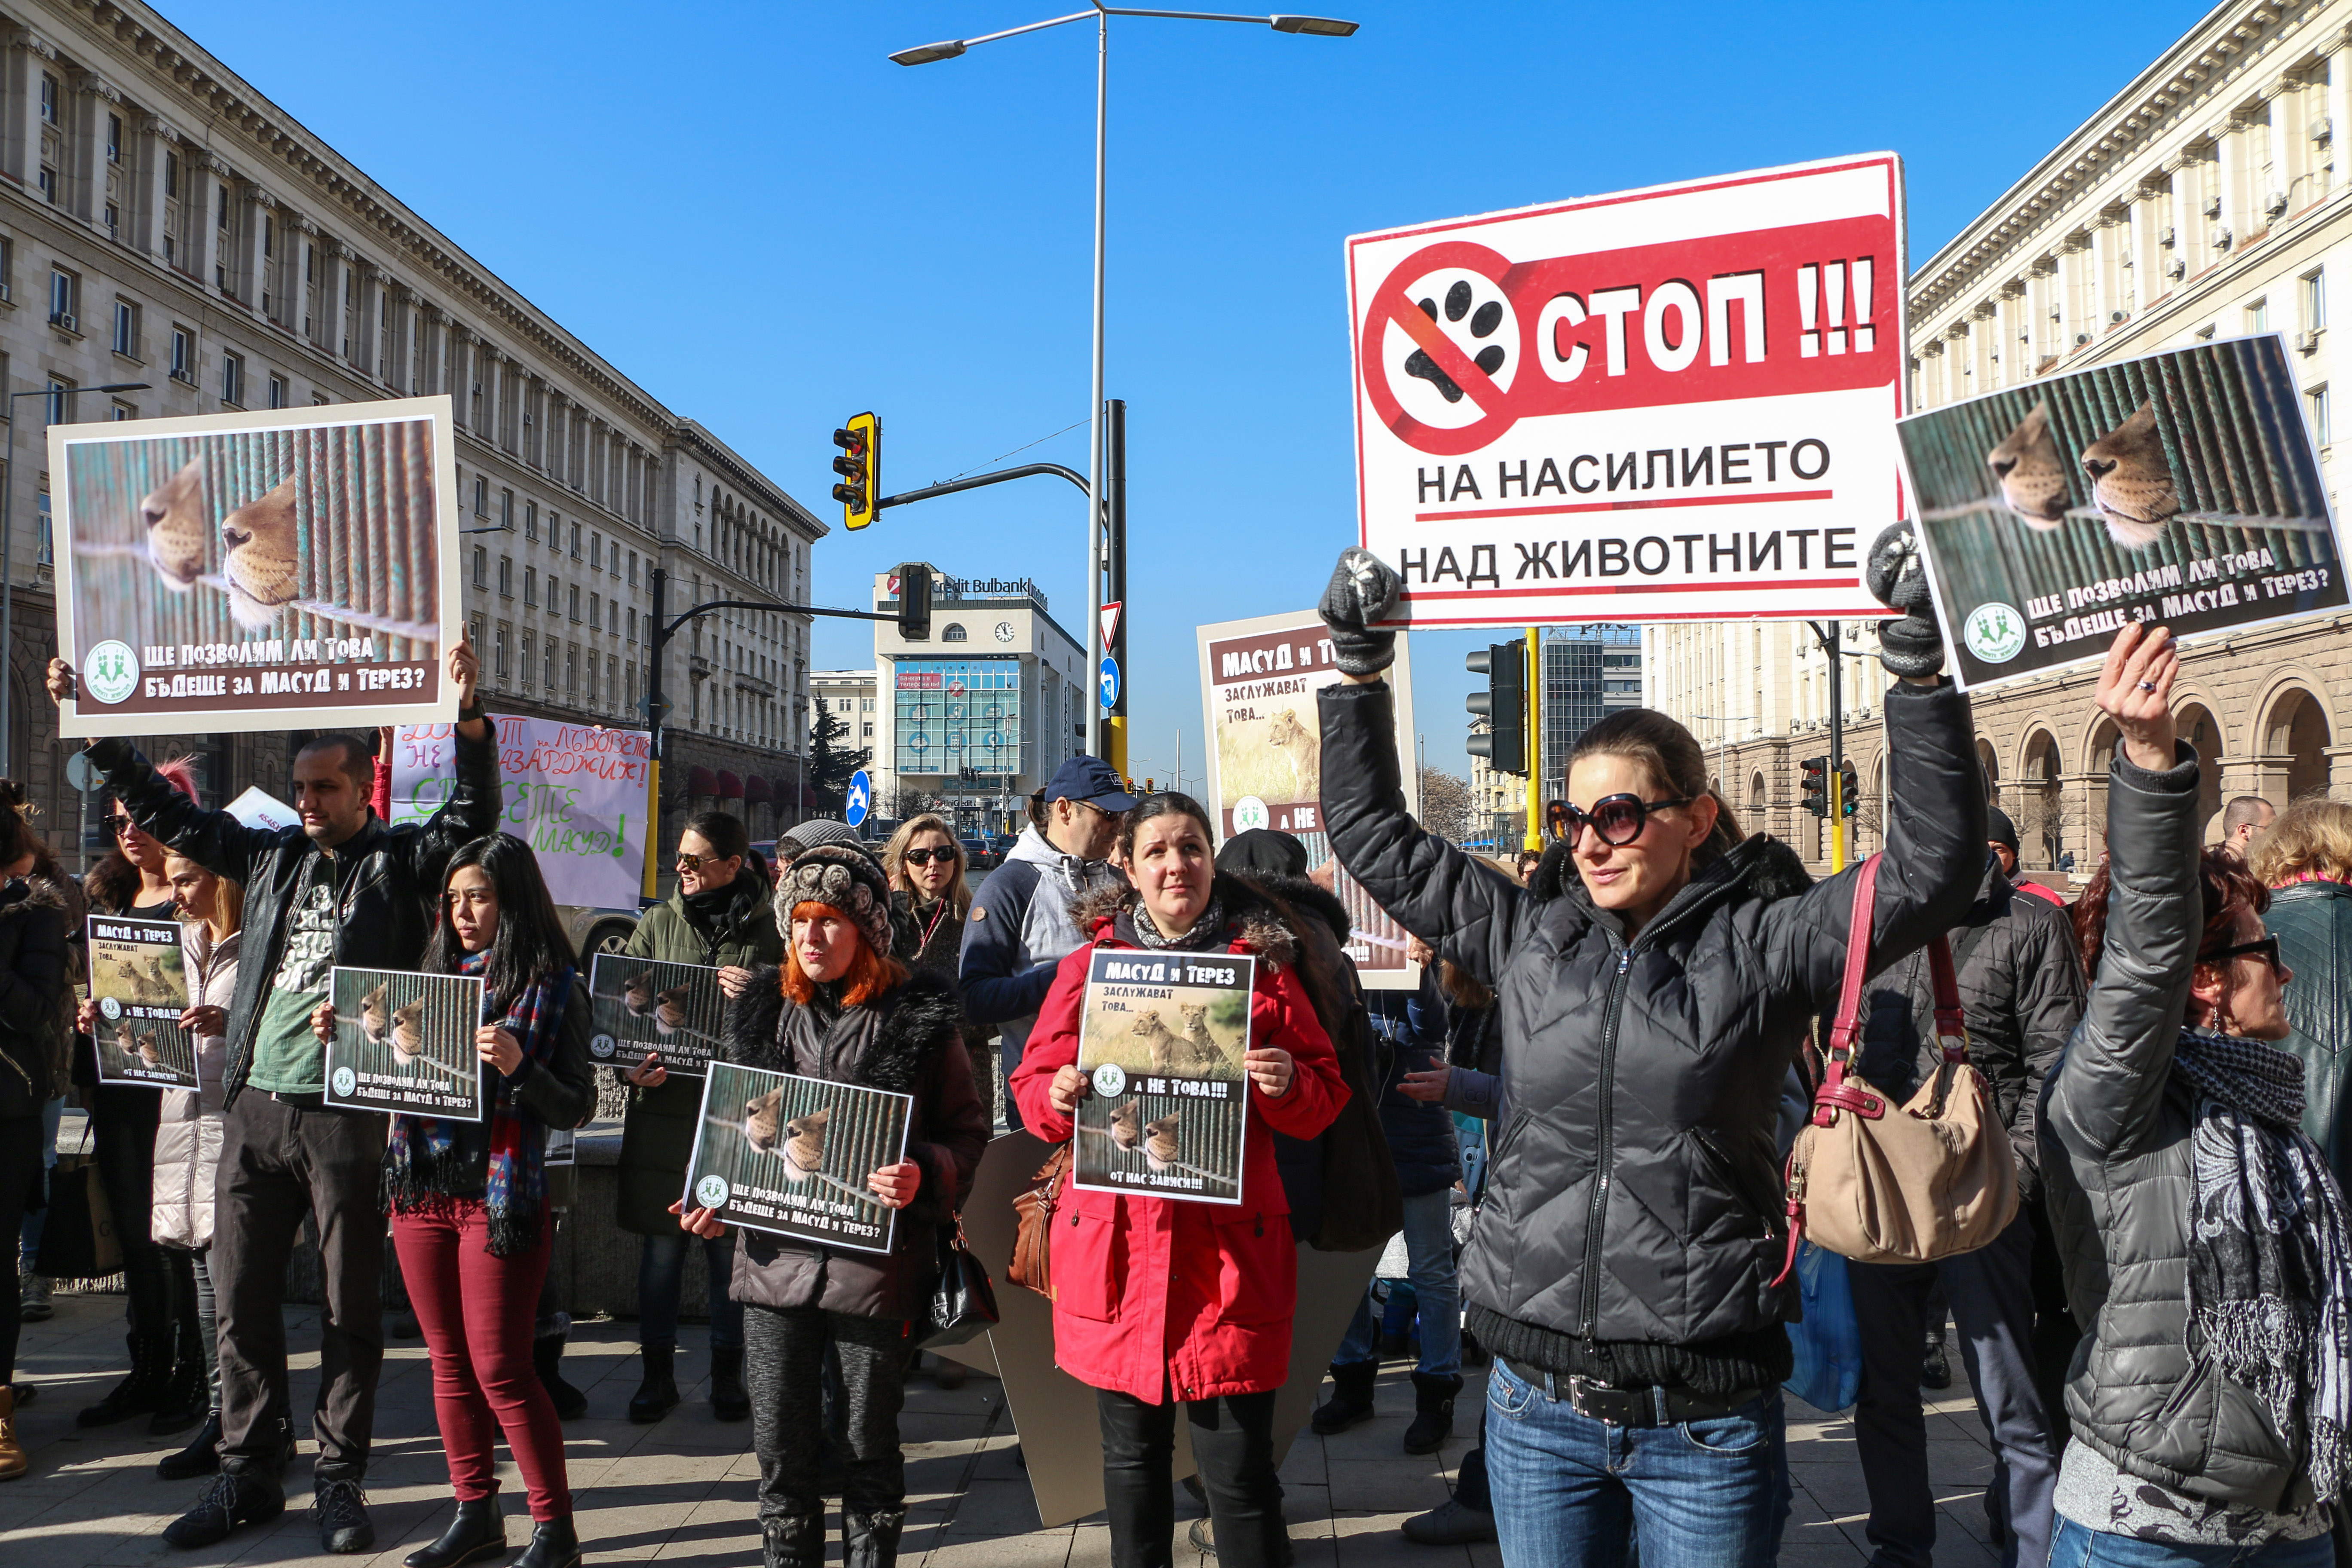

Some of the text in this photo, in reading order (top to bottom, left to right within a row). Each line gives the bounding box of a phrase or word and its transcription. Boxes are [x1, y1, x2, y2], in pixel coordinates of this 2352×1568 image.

[1537, 256, 1876, 383] СТОП !!!
[1417, 438, 1831, 504] НА НАСИЛИЕТО
[1400, 527, 1857, 590] НАД ЖИВОТНИТЕ
[973, 578, 1028, 593] Bulbank
[2027, 548, 2274, 619] ЩЕ ПОЗВОЛИМ ЛИ ТОВА
[2034, 607, 2128, 649] БЪДЕЩЕ
[2161, 584, 2239, 620] МАСУД
[2261, 570, 2329, 599] ТЕРЕЗ?
[145, 637, 374, 667] ЩЕ ПОЗВОЛИМ ЛИ ТОВА
[1222, 643, 1293, 678] МАСУД
[145, 674, 226, 698] БЪДЕЩЕ
[233, 677, 254, 695] ЗА
[260, 669, 331, 695] МАСУД
[356, 668, 425, 691] ТЕРЕЗ?
[1225, 678, 1307, 702] ЗАСЛУЖАВАТ
[1227, 707, 1265, 723] ТОВА...
[406, 744, 441, 769] НЕ
[497, 747, 646, 788] АЗАРДЖИК!
[1293, 807, 1315, 829] НЕ
[97, 924, 132, 940] МАСУД
[143, 928, 173, 943] ТЕРЕЗ
[98, 942, 138, 952] ЗАСЛУЖАВАТ
[1105, 962, 1165, 983] МАСУД
[1186, 965, 1235, 985] ТЕРЕЗ
[1103, 986, 1174, 1000] ЗАСЛУЖАВАТ
[133, 1006, 144, 1017] НЕ
[146, 1007, 181, 1020] ТОВА!!!
[616, 1050, 646, 1061] БЪДЕЩ
[665, 1055, 693, 1066] МАСУД
[618, 1039, 711, 1057] ЩЕ ПОЗВОЛИМ ЛИ ТОВА
[133, 1069, 146, 1078] НАС
[358, 1072, 450, 1091] ЩЕ ПОЗВОЛИМ ЛИ ТОВА
[356, 1086, 391, 1099] БЪДЕЩЕ
[392, 1092, 401, 1101] ЗА
[404, 1091, 432, 1105] МАСУД
[443, 1095, 472, 1108] ТЕРЕЗ?
[1147, 1078, 1166, 1095] НЕ
[1171, 1078, 1228, 1099] ТОВА!!!
[1110, 1171, 1203, 1190] ОТ НАС ЗАВИСИ!!!
[732, 1183, 854, 1217] ЩЕ ПОЗВОЛИМ ЛИ ТОВА
[729, 1198, 774, 1218] БЪДЕЩЕ
[776, 1210, 789, 1221] ЗА
[791, 1211, 829, 1230] МАСУД
[842, 1220, 881, 1239] ТЕРЕЗ?
